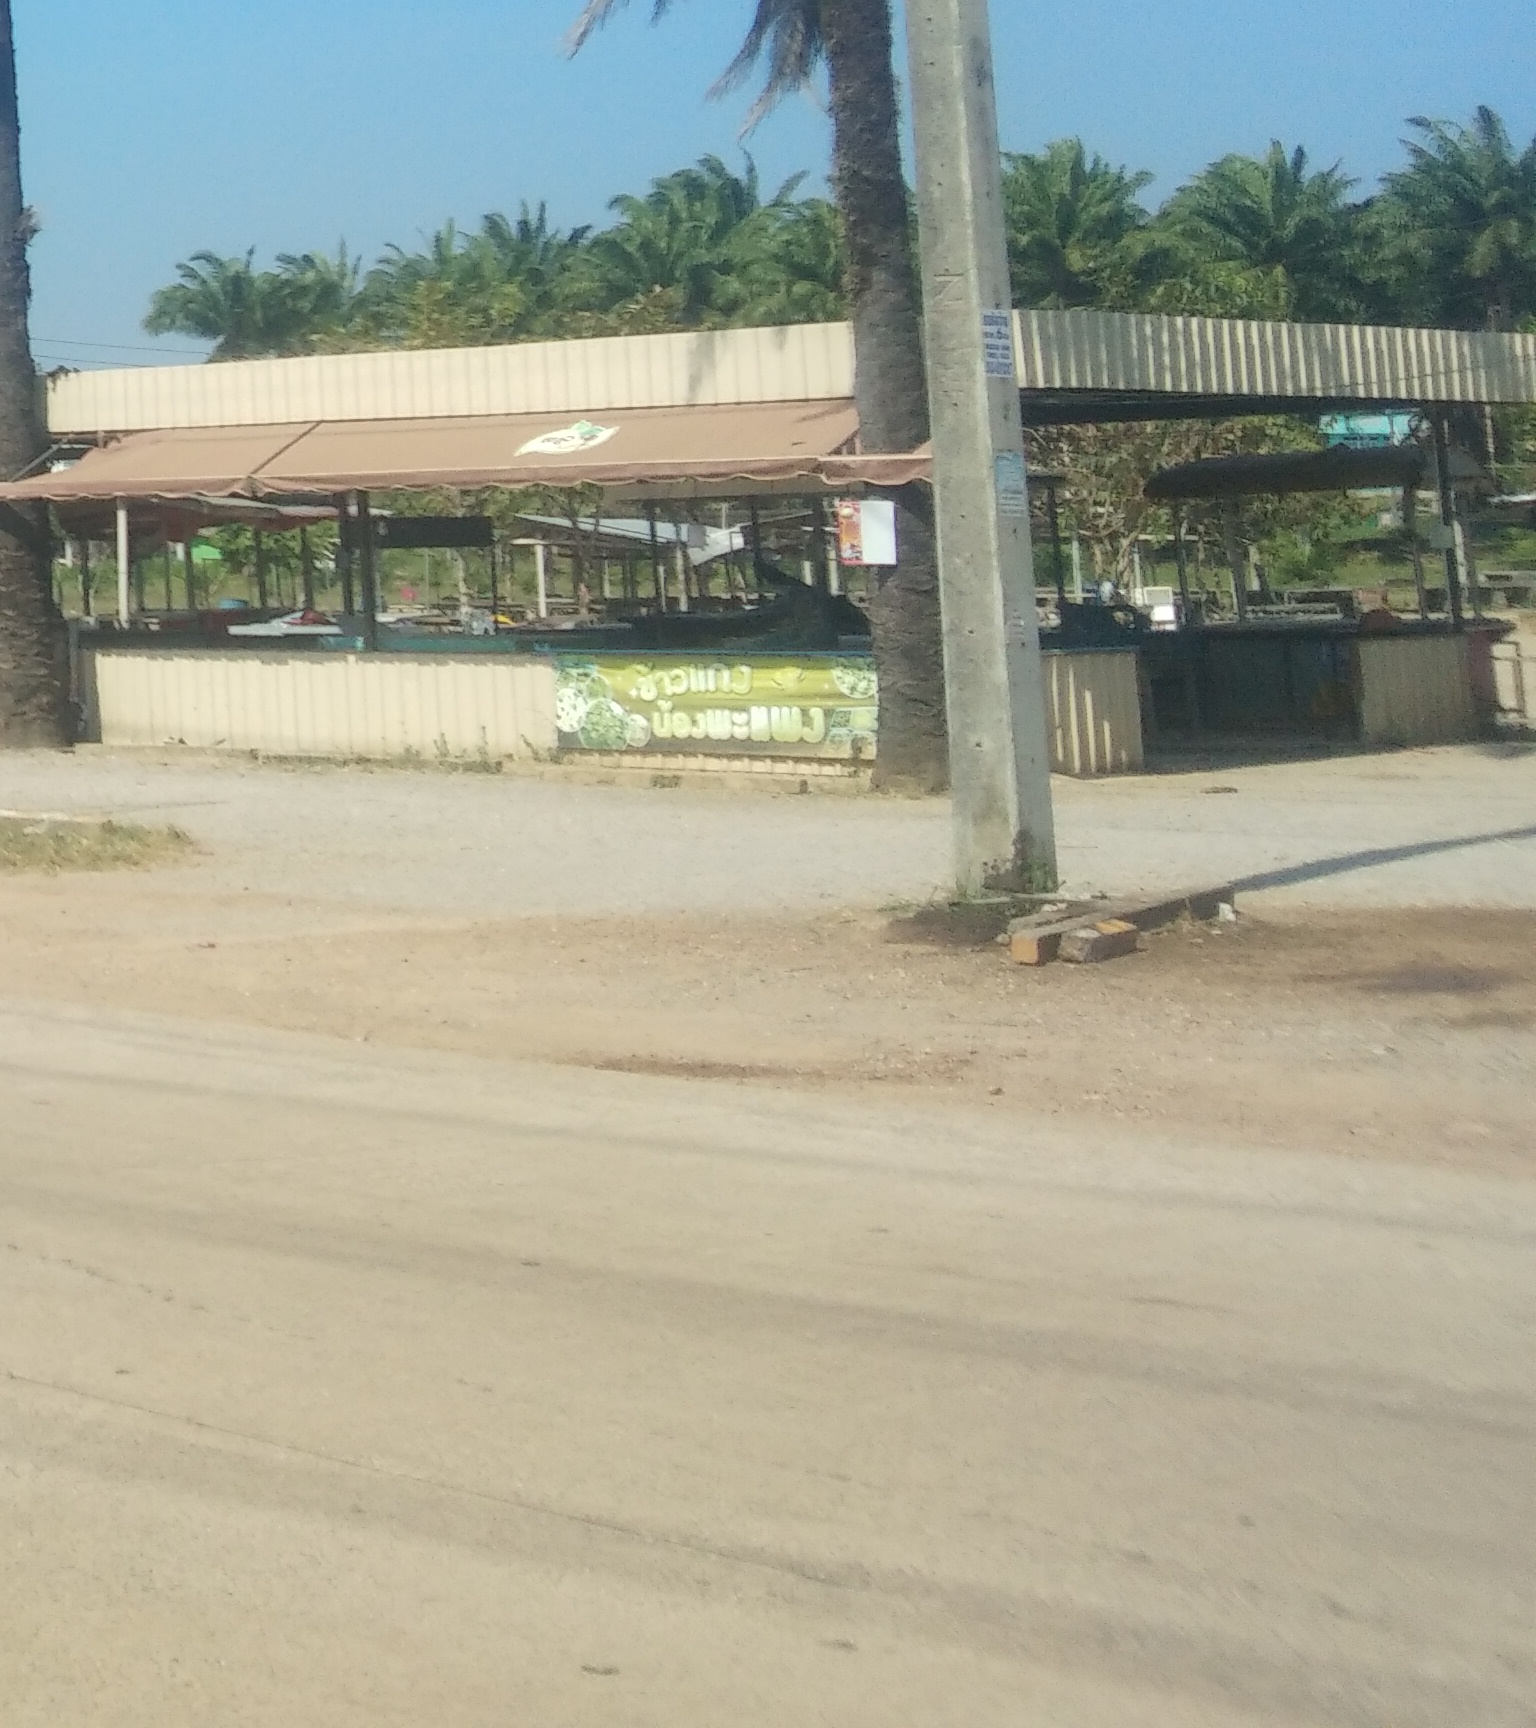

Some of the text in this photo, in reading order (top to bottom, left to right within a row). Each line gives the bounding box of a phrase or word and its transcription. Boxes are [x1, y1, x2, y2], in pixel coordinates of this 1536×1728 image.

[635, 661, 753, 702] ข้าวแกง
[652, 699, 826, 744] น้องพะแพง
